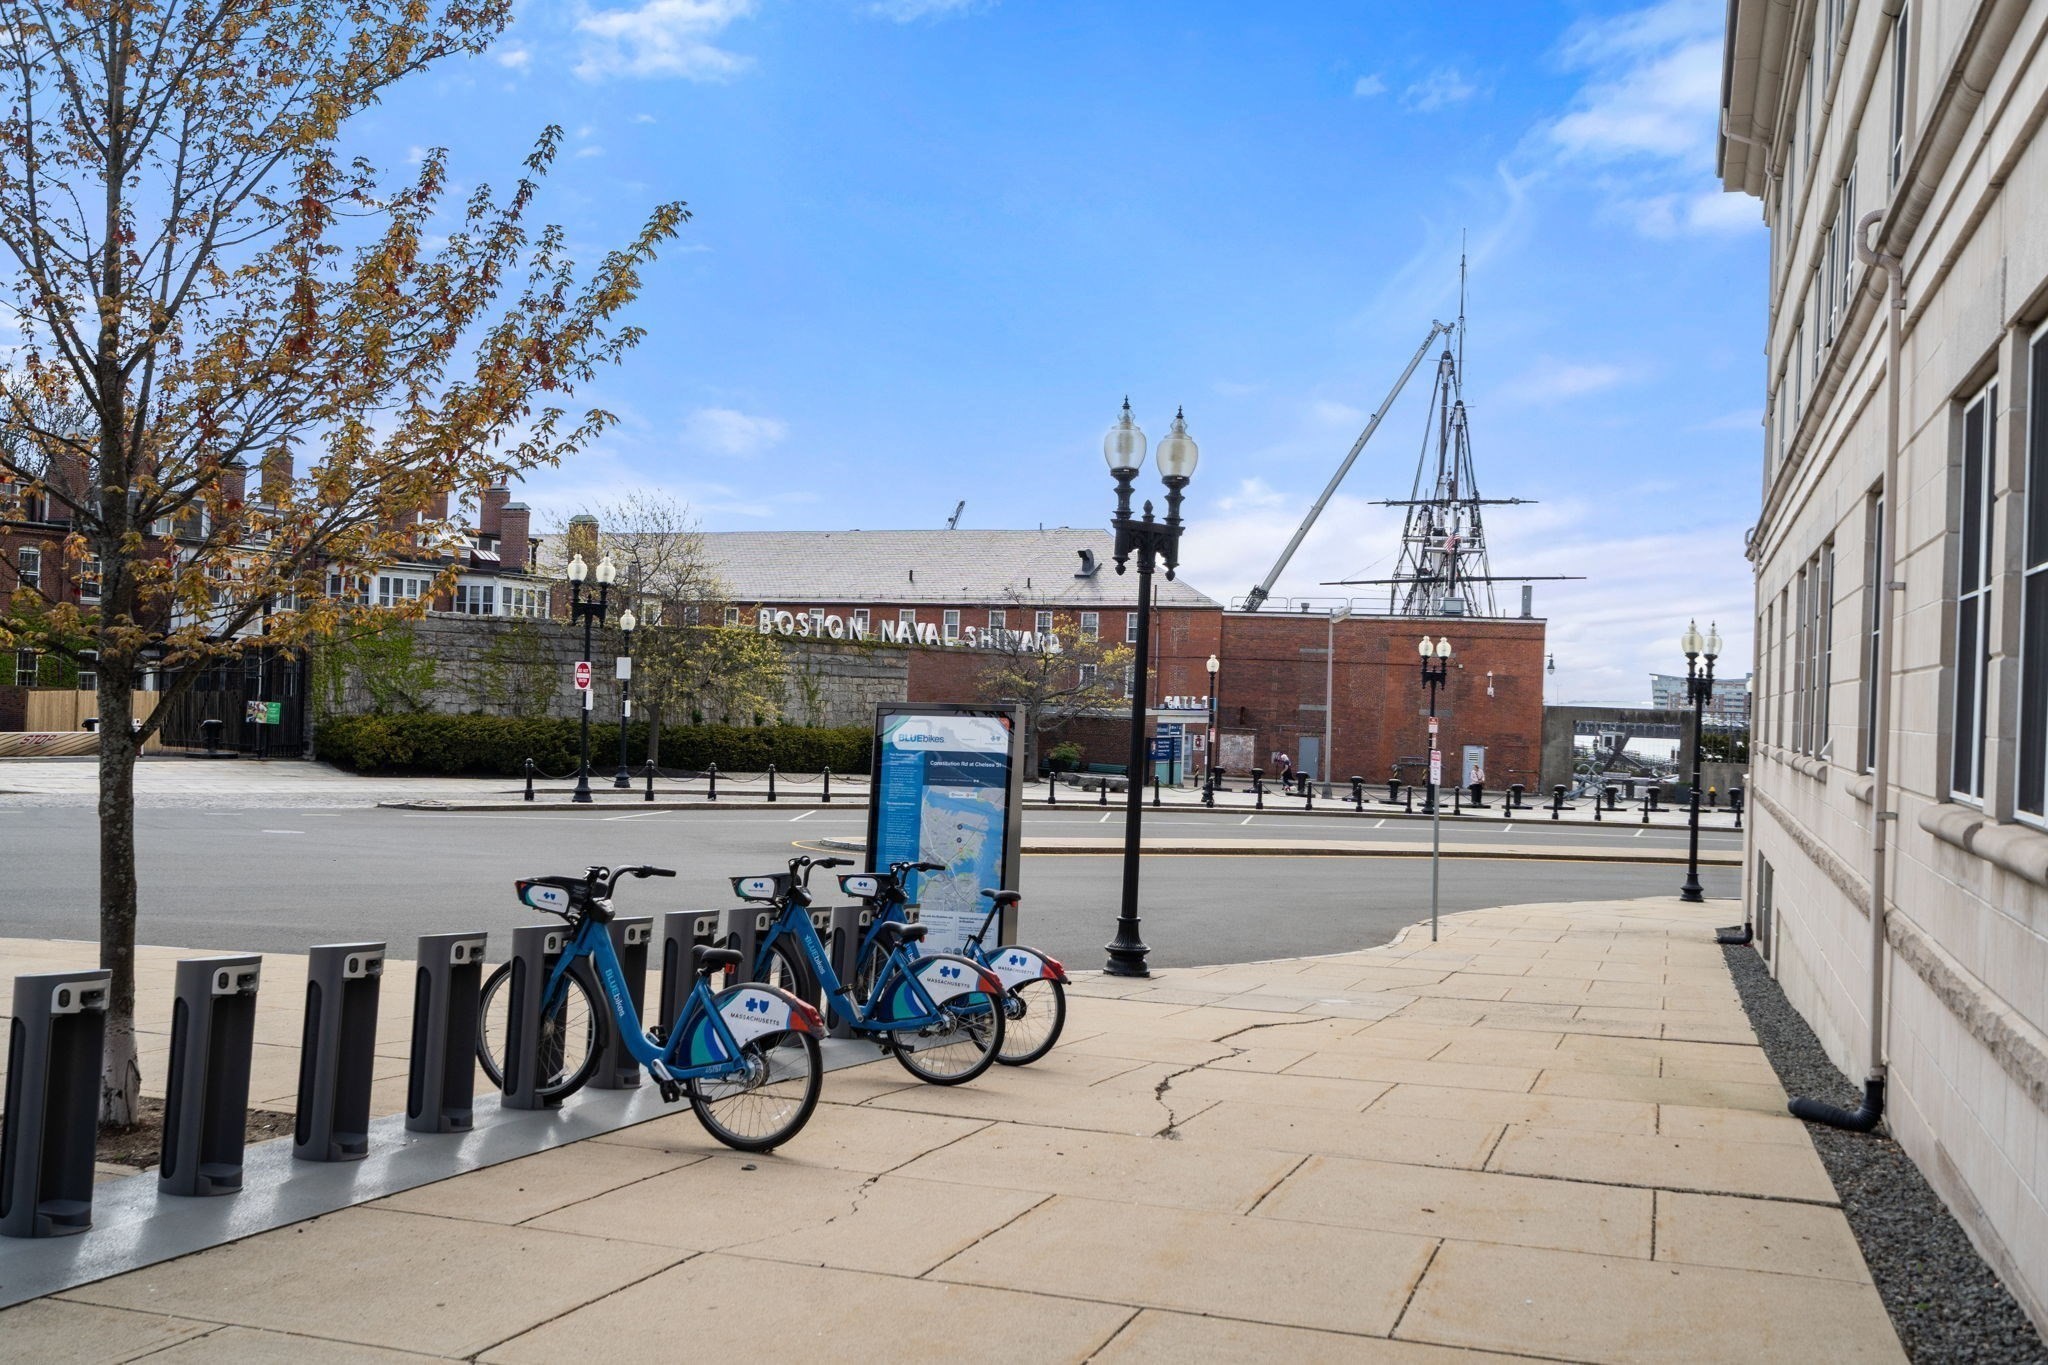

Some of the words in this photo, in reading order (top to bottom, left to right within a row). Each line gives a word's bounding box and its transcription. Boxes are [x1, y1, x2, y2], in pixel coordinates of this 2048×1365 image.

[759, 608, 863, 640] BOSTON
[881, 619, 954, 647] NAVAL
[20, 735, 57, 745] STOP
[898, 733, 945, 743] BLUEbikes
[998, 966, 1035, 976] MASSACHUSETTS
[926, 977, 971, 989] MASSACHUSETTS
[730, 1012, 780, 1026] MASSACHUSETTS
